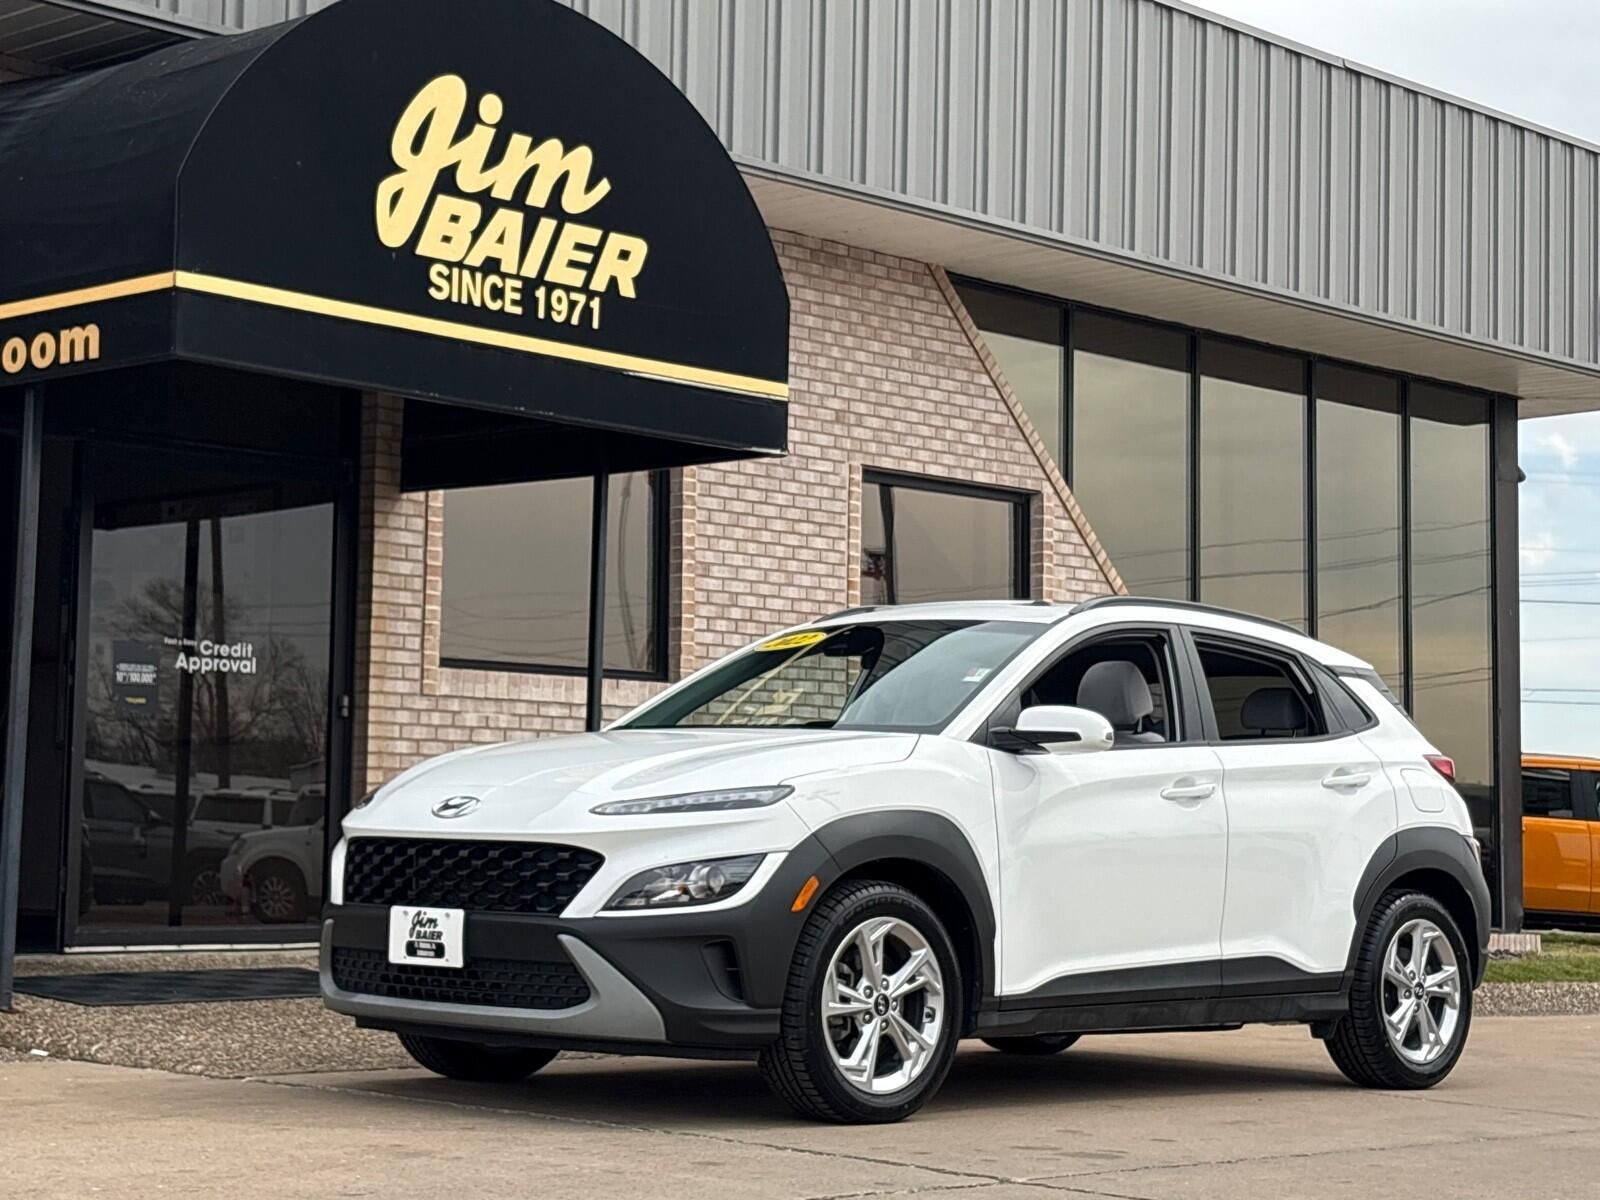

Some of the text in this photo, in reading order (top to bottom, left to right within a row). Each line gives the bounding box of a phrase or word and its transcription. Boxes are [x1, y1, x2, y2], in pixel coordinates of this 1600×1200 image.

[376, 74, 612, 248] Jim
[414, 194, 648, 299] BAIER
[428, 263, 601, 330] SINCE 1971
[175, 652, 256, 674] Approval
[200, 640, 253, 657] Credit
[409, 910, 438, 939] Jim
[415, 930, 443, 940] BAIER
